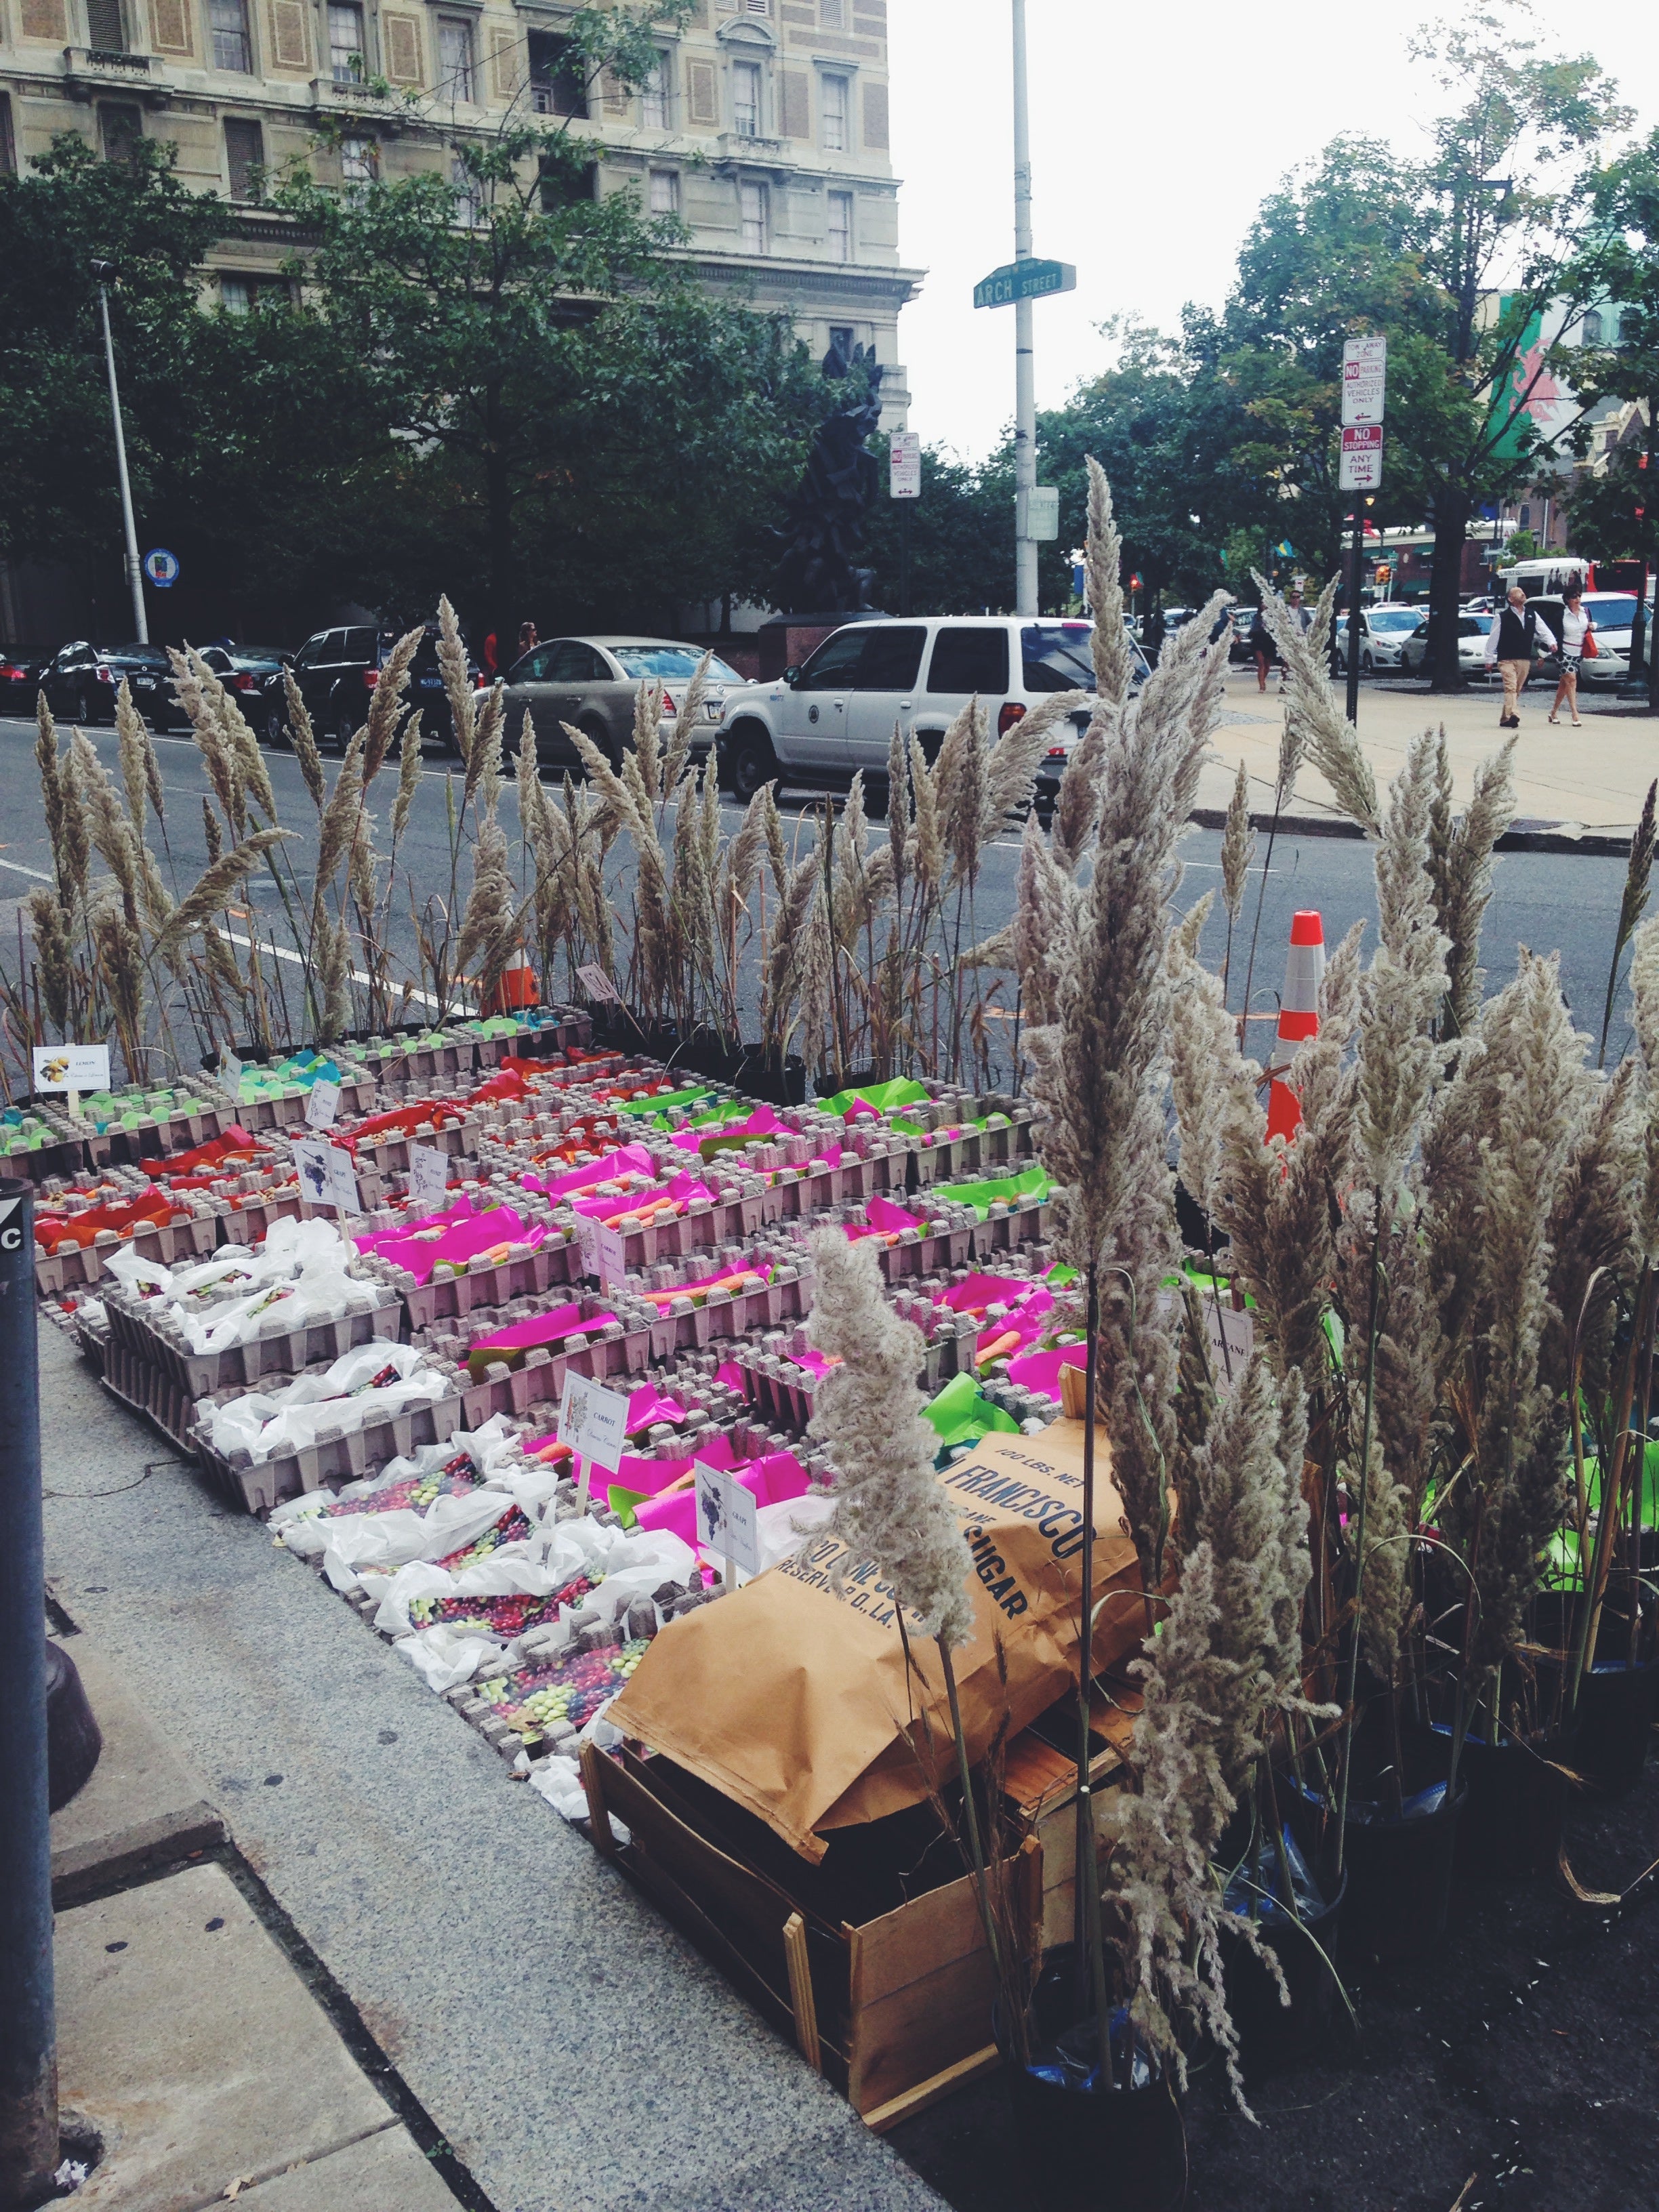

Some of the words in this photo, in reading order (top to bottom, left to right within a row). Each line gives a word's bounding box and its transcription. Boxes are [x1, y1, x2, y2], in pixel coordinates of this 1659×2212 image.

[977, 279, 1012, 306] ARCH
[1021, 273, 1057, 295] STREET
[1346, 365, 1359, 377] NO
[1347, 388, 1380, 397] VEHICLES
[1354, 428, 1370, 441] NO
[1344, 440, 1380, 451] STOPPING
[1350, 455, 1372, 464] ANY
[1348, 464, 1374, 473] TIME
[1, 1228, 22, 1250] C
[594, 1412, 615, 1427] CARROT
[995, 1448, 1025, 1460] 100
[1021, 1458, 1055, 1476] LBS.
[1053, 1473, 1085, 1488] NET
[944, 1465, 1097, 1559] FRANCISCO
